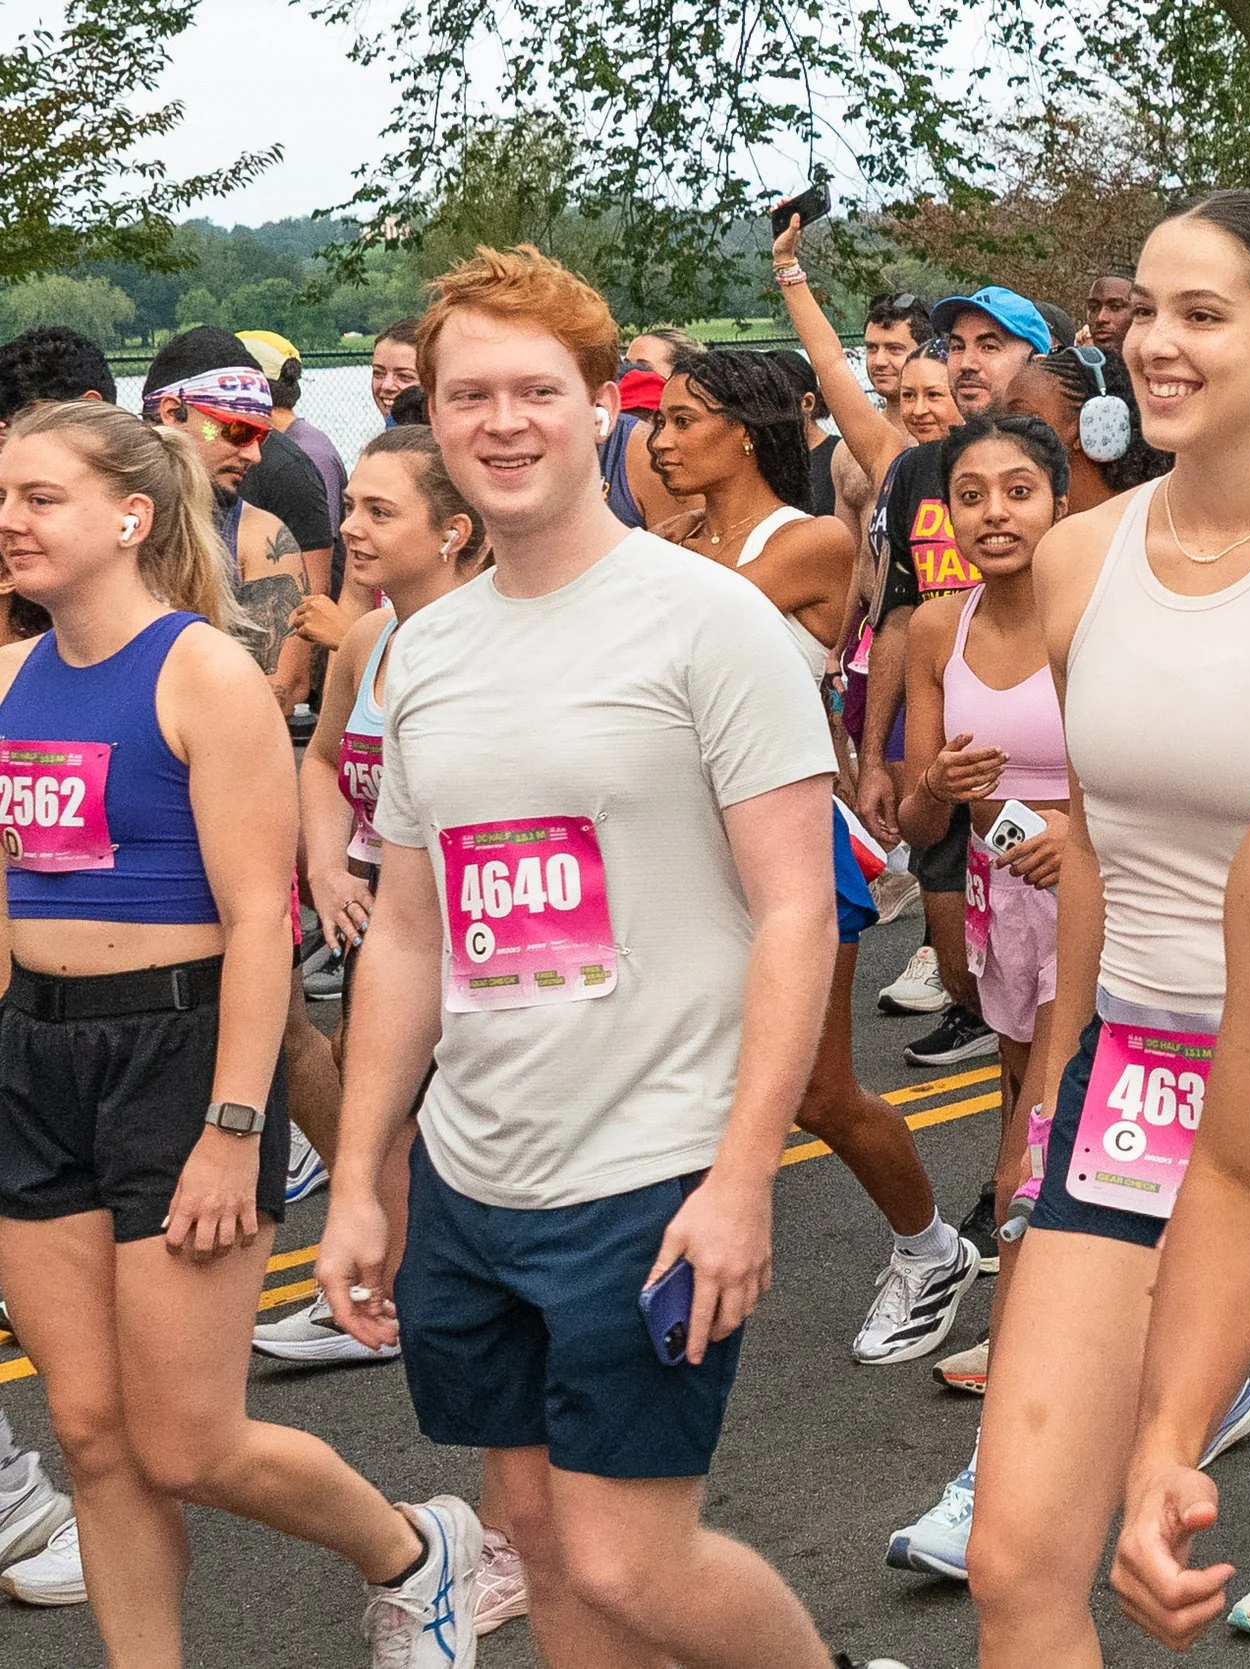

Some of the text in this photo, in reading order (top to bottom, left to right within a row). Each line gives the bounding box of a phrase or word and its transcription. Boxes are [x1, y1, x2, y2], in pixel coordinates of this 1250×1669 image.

[0, 774, 87, 828] 2562
[460, 852, 582, 920] 4640
[471, 931, 488, 956] C
[1106, 1063, 1206, 1131] 463
[1114, 1129, 1136, 1152] C
